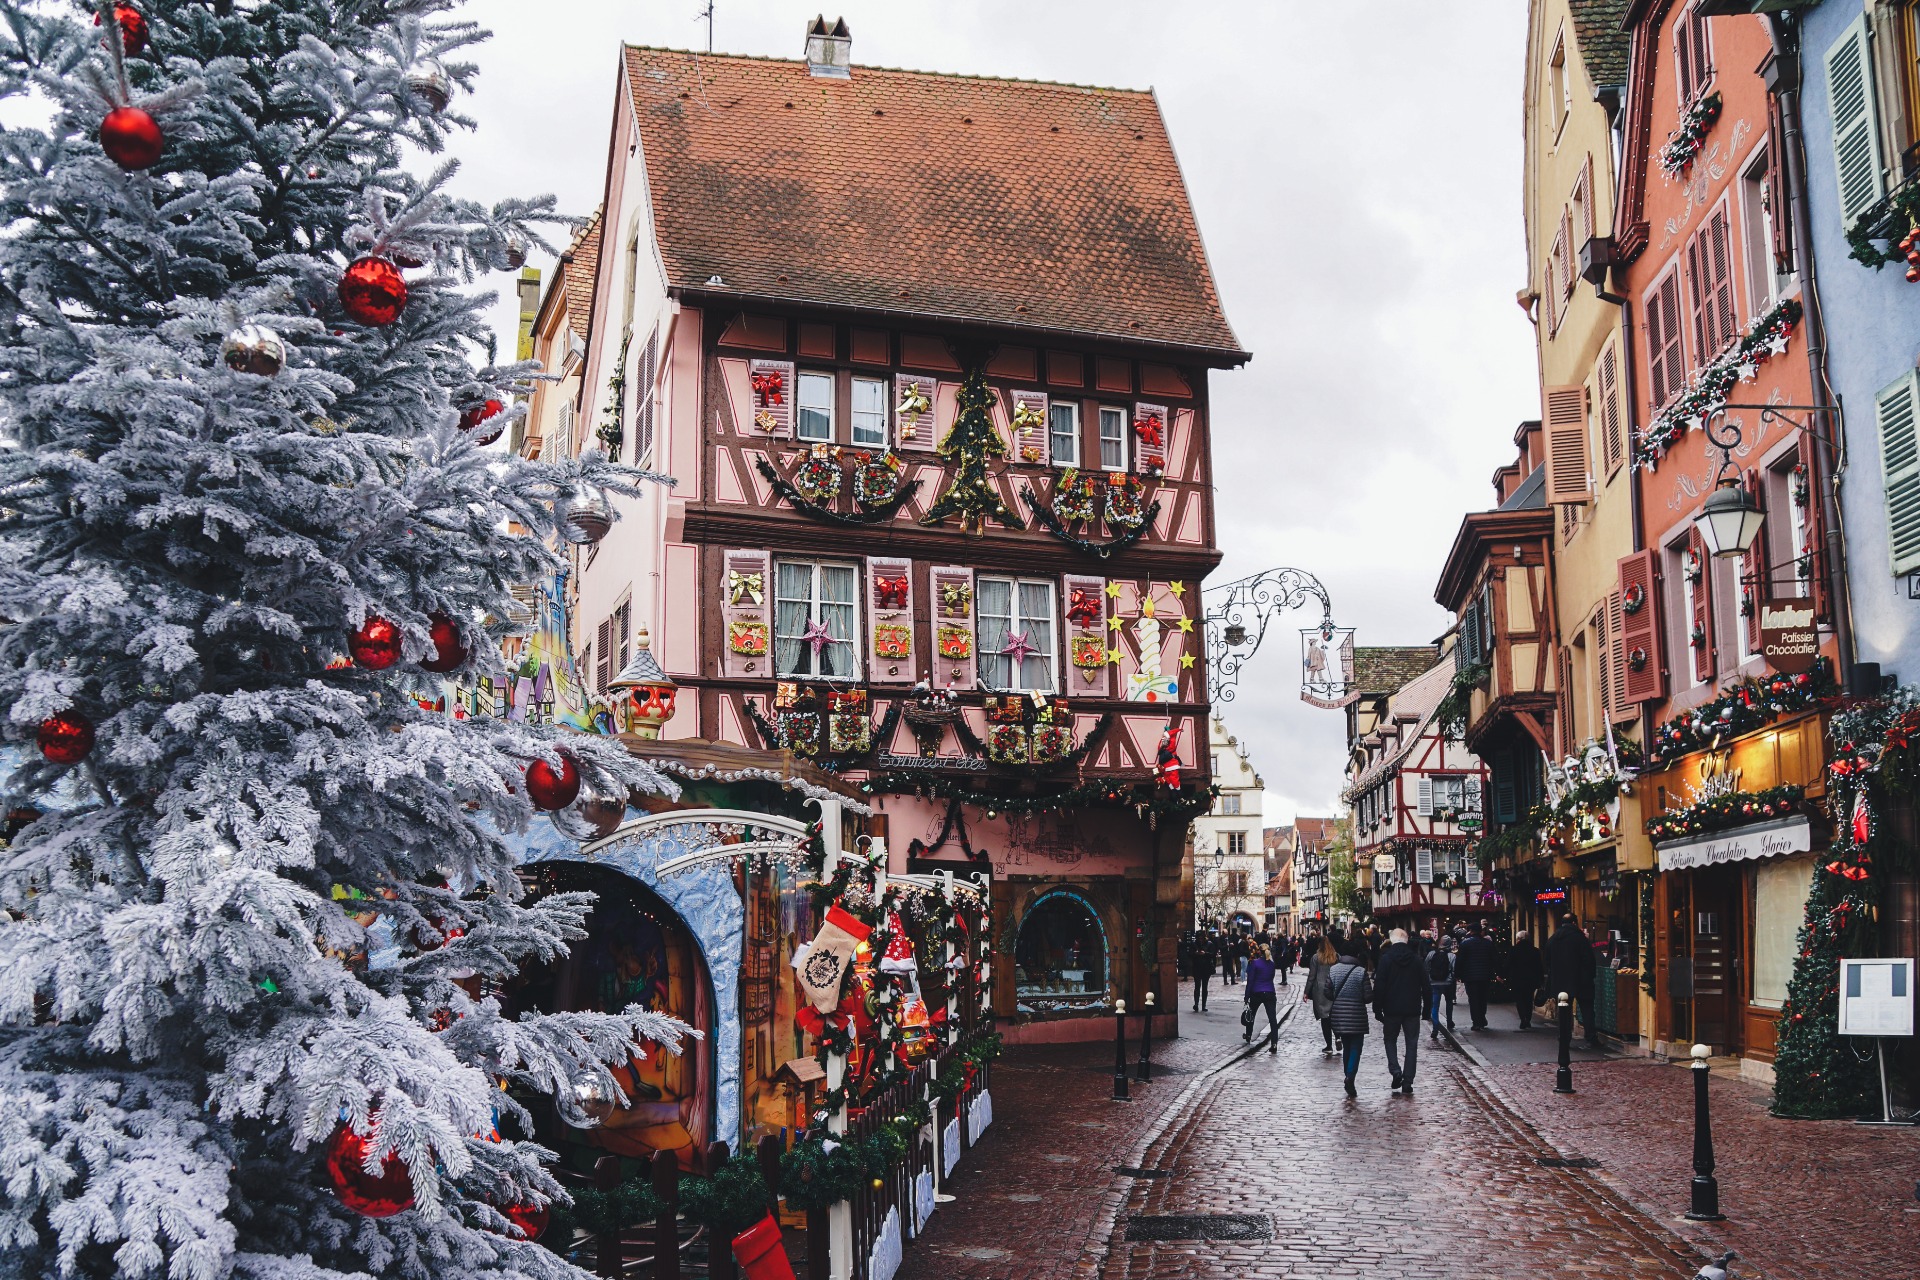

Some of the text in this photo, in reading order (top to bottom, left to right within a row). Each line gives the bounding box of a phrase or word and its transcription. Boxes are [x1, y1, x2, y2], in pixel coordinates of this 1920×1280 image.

[1761, 605, 1814, 630] Lorber
[1766, 643, 1817, 656] Chocolatier
[1706, 841, 1747, 862] Chocolatier
[1760, 834, 1792, 854] Glacier
